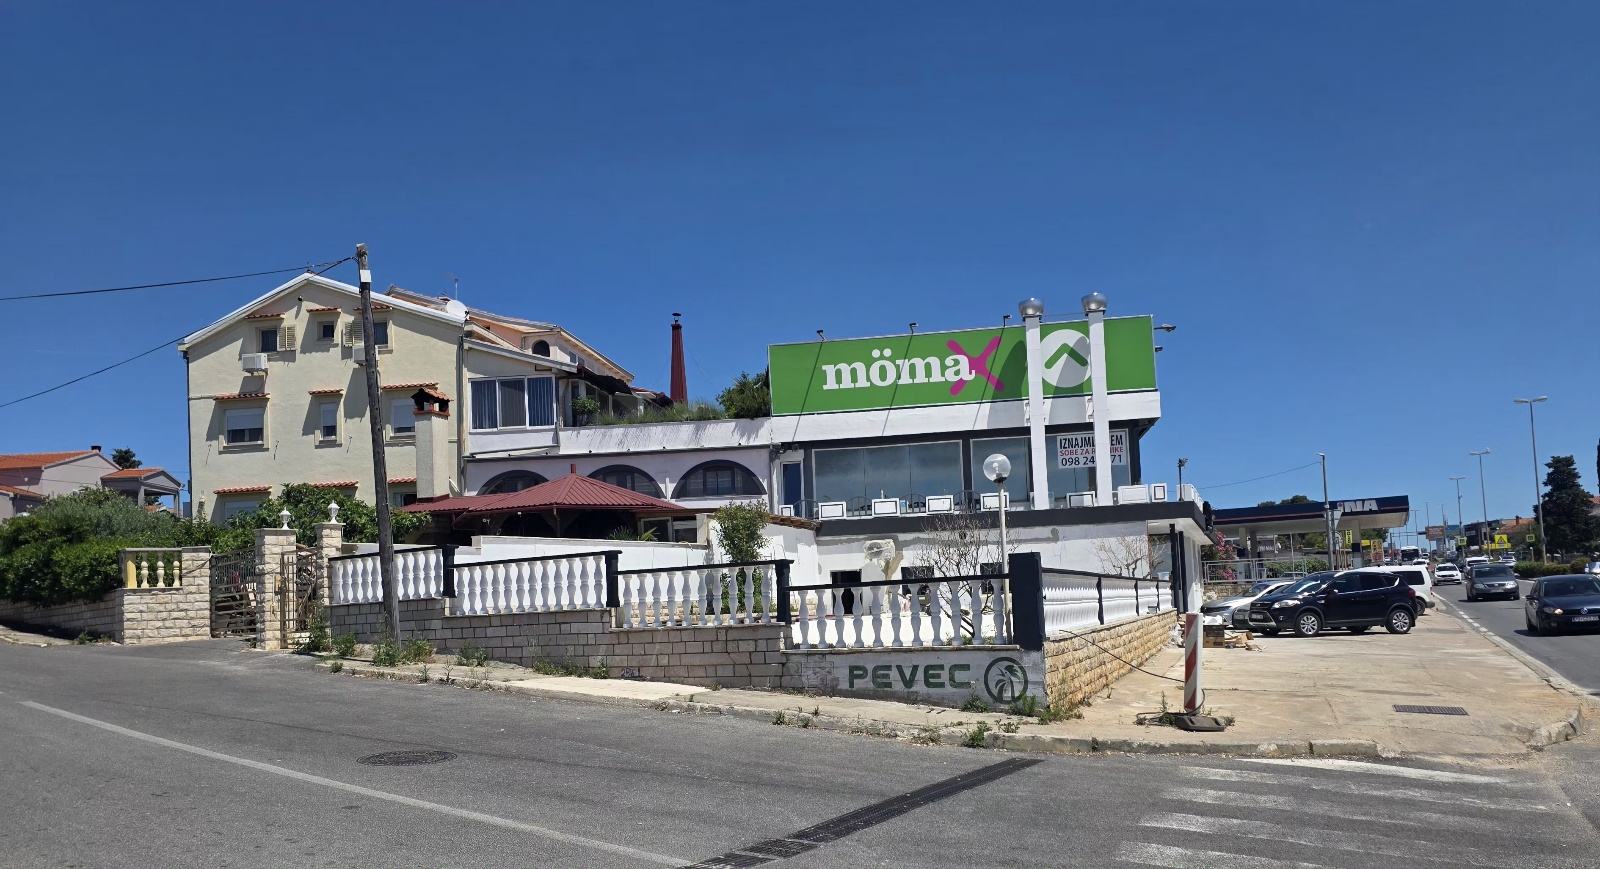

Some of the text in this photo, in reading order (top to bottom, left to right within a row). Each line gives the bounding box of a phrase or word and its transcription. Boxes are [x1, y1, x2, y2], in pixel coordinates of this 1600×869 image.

[1060, 448, 1079, 456] SOBE
[1061, 456, 1080, 466] 098
[1336, 500, 1378, 513] INA
[848, 663, 971, 689] PEVEC
